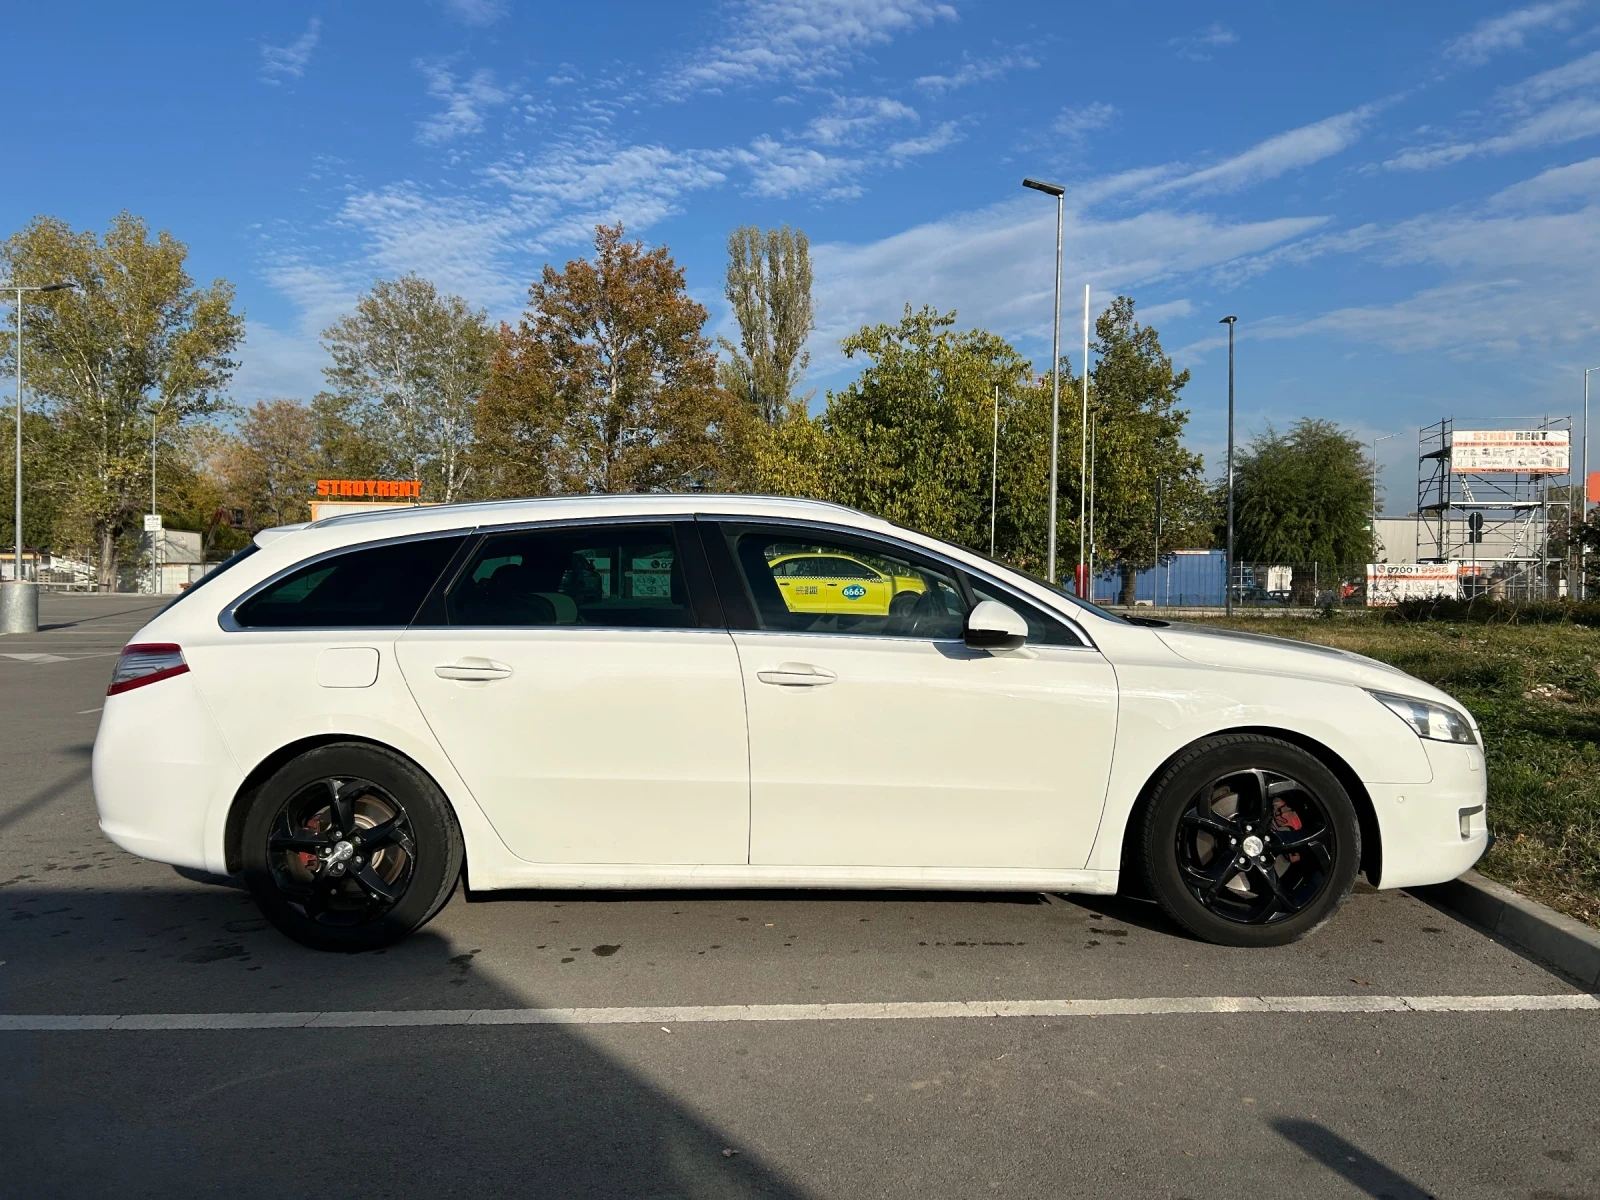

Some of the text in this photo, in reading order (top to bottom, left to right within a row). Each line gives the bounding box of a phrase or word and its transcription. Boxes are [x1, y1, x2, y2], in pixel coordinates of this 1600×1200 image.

[1473, 431, 1548, 441] STROYRENT
[317, 479, 422, 497] STROYRENT
[843, 588, 865, 596] 6665
